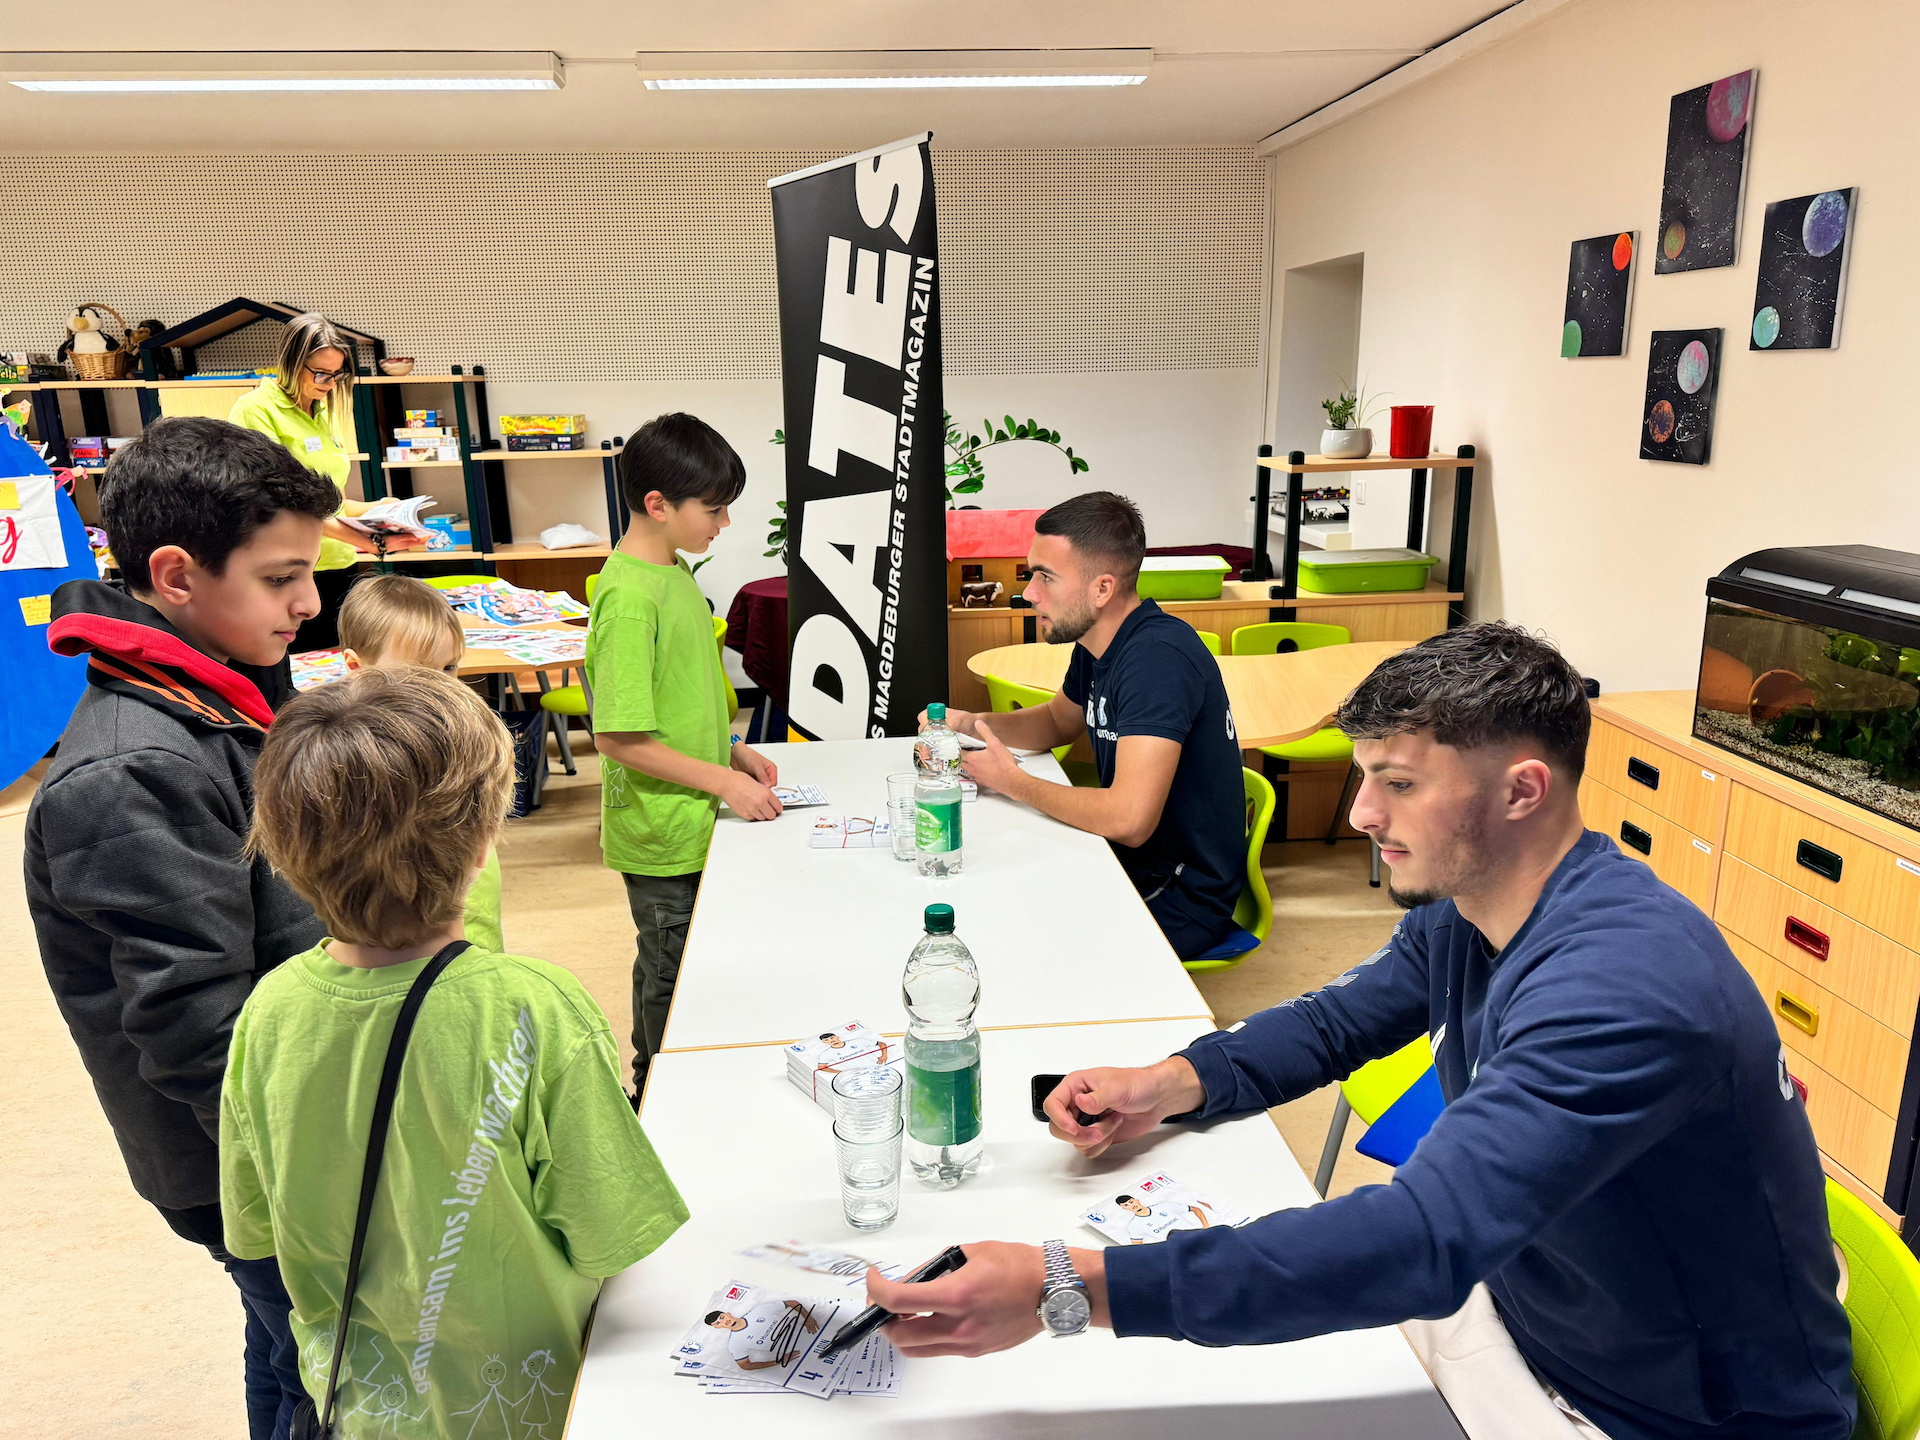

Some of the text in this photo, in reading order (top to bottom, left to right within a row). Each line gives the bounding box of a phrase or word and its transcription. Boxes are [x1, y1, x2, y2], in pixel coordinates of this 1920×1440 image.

[789, 144, 924, 742] DATES
[874, 509, 907, 724] MAGDEBURGER
[895, 257, 935, 502] STADTMAGAZIN
[412, 1008, 538, 1395] gemeinsam ins Leben wachsen
[798, 1370, 824, 1381] 4
